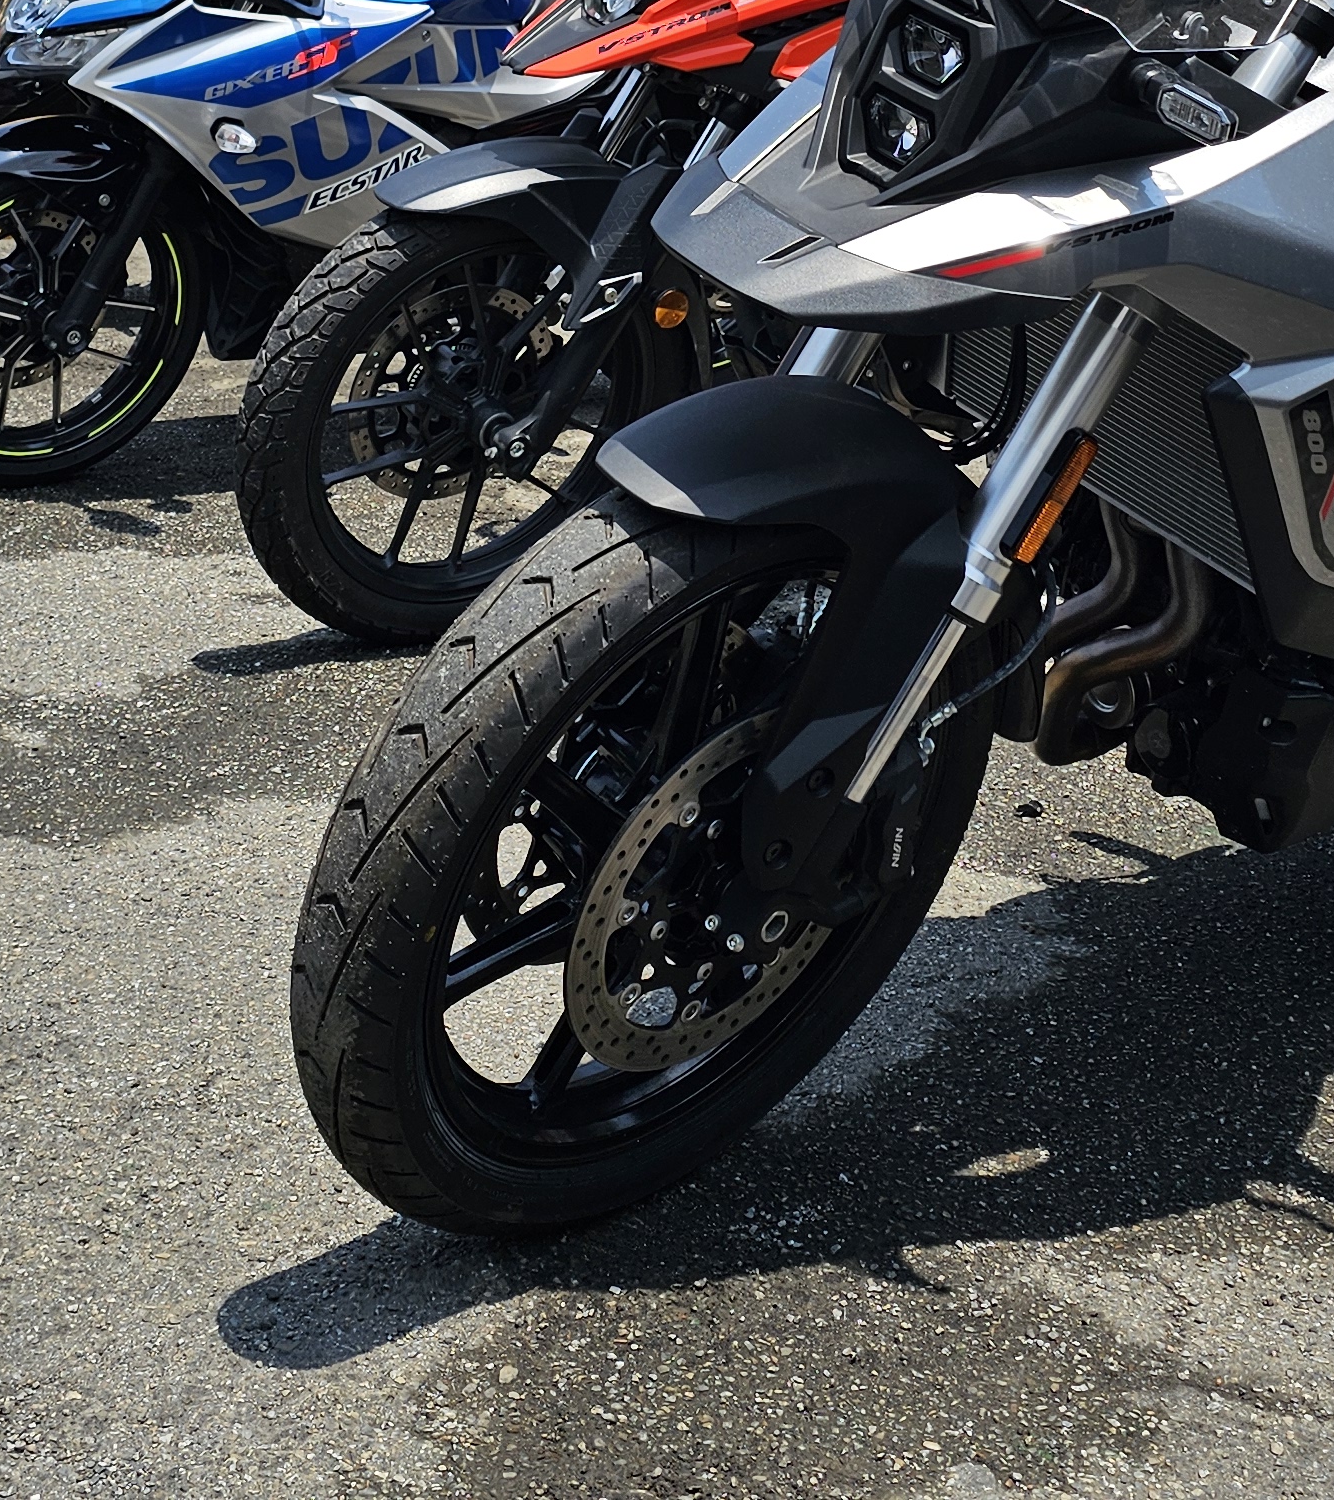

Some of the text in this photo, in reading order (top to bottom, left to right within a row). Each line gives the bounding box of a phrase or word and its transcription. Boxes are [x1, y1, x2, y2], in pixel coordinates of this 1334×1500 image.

[204, 30, 359, 100] GIXXER SF
[308, 146, 429, 211] ECSTAR
[1045, 211, 1175, 254] V-STROM
[1302, 409, 1328, 474] 800
